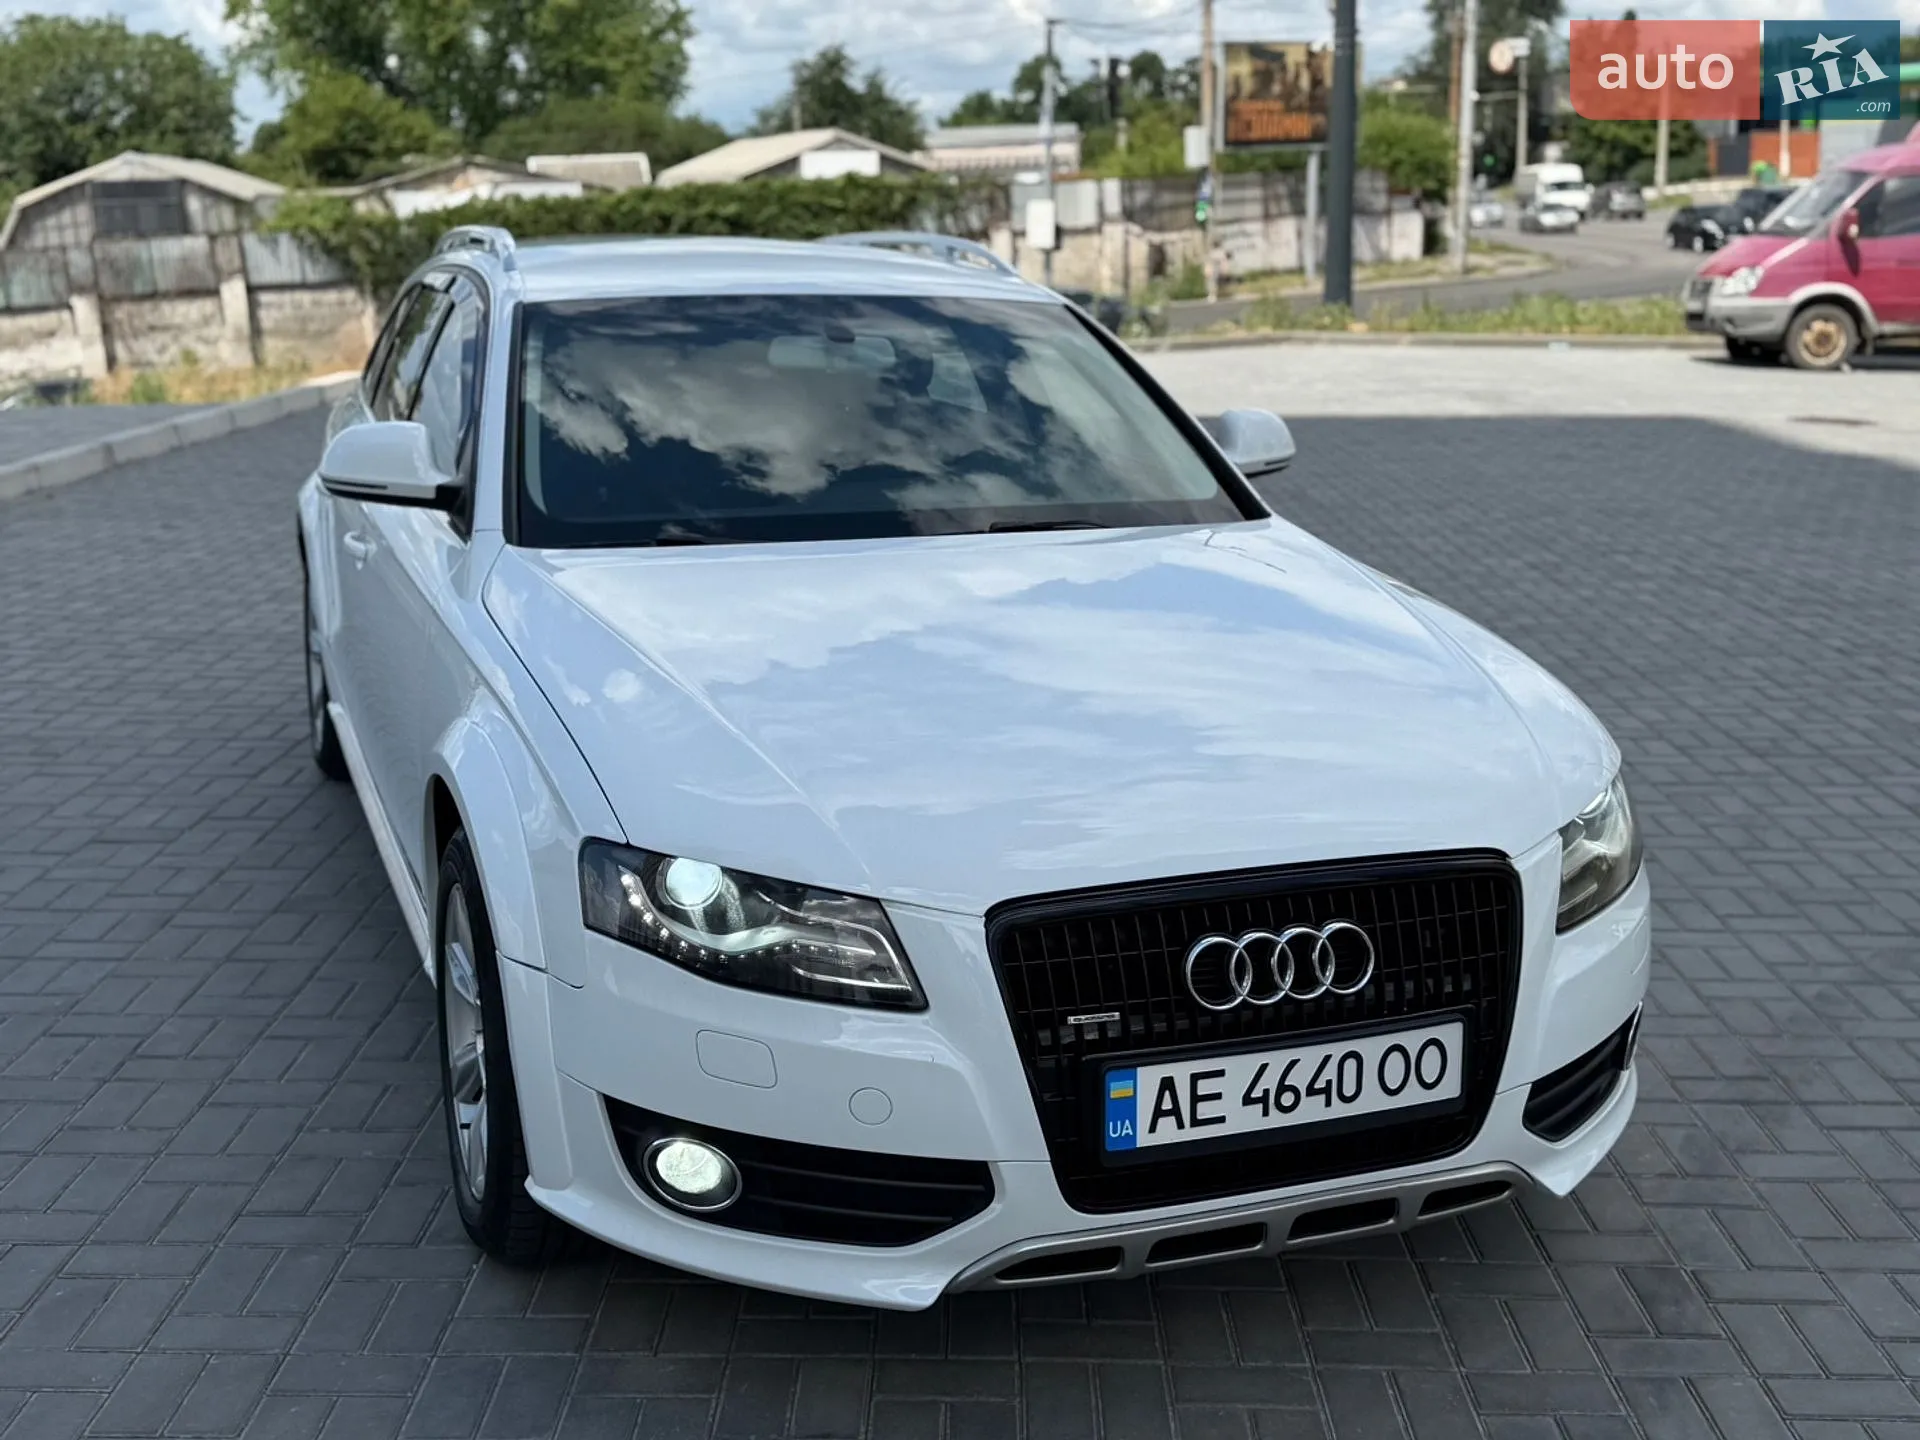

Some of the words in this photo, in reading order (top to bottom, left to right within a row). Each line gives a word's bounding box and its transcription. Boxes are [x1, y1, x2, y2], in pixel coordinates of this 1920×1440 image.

[1148, 1069, 1227, 1134] AE
[1241, 1050, 1364, 1118] 4640
[1109, 1120, 1133, 1138] UA
